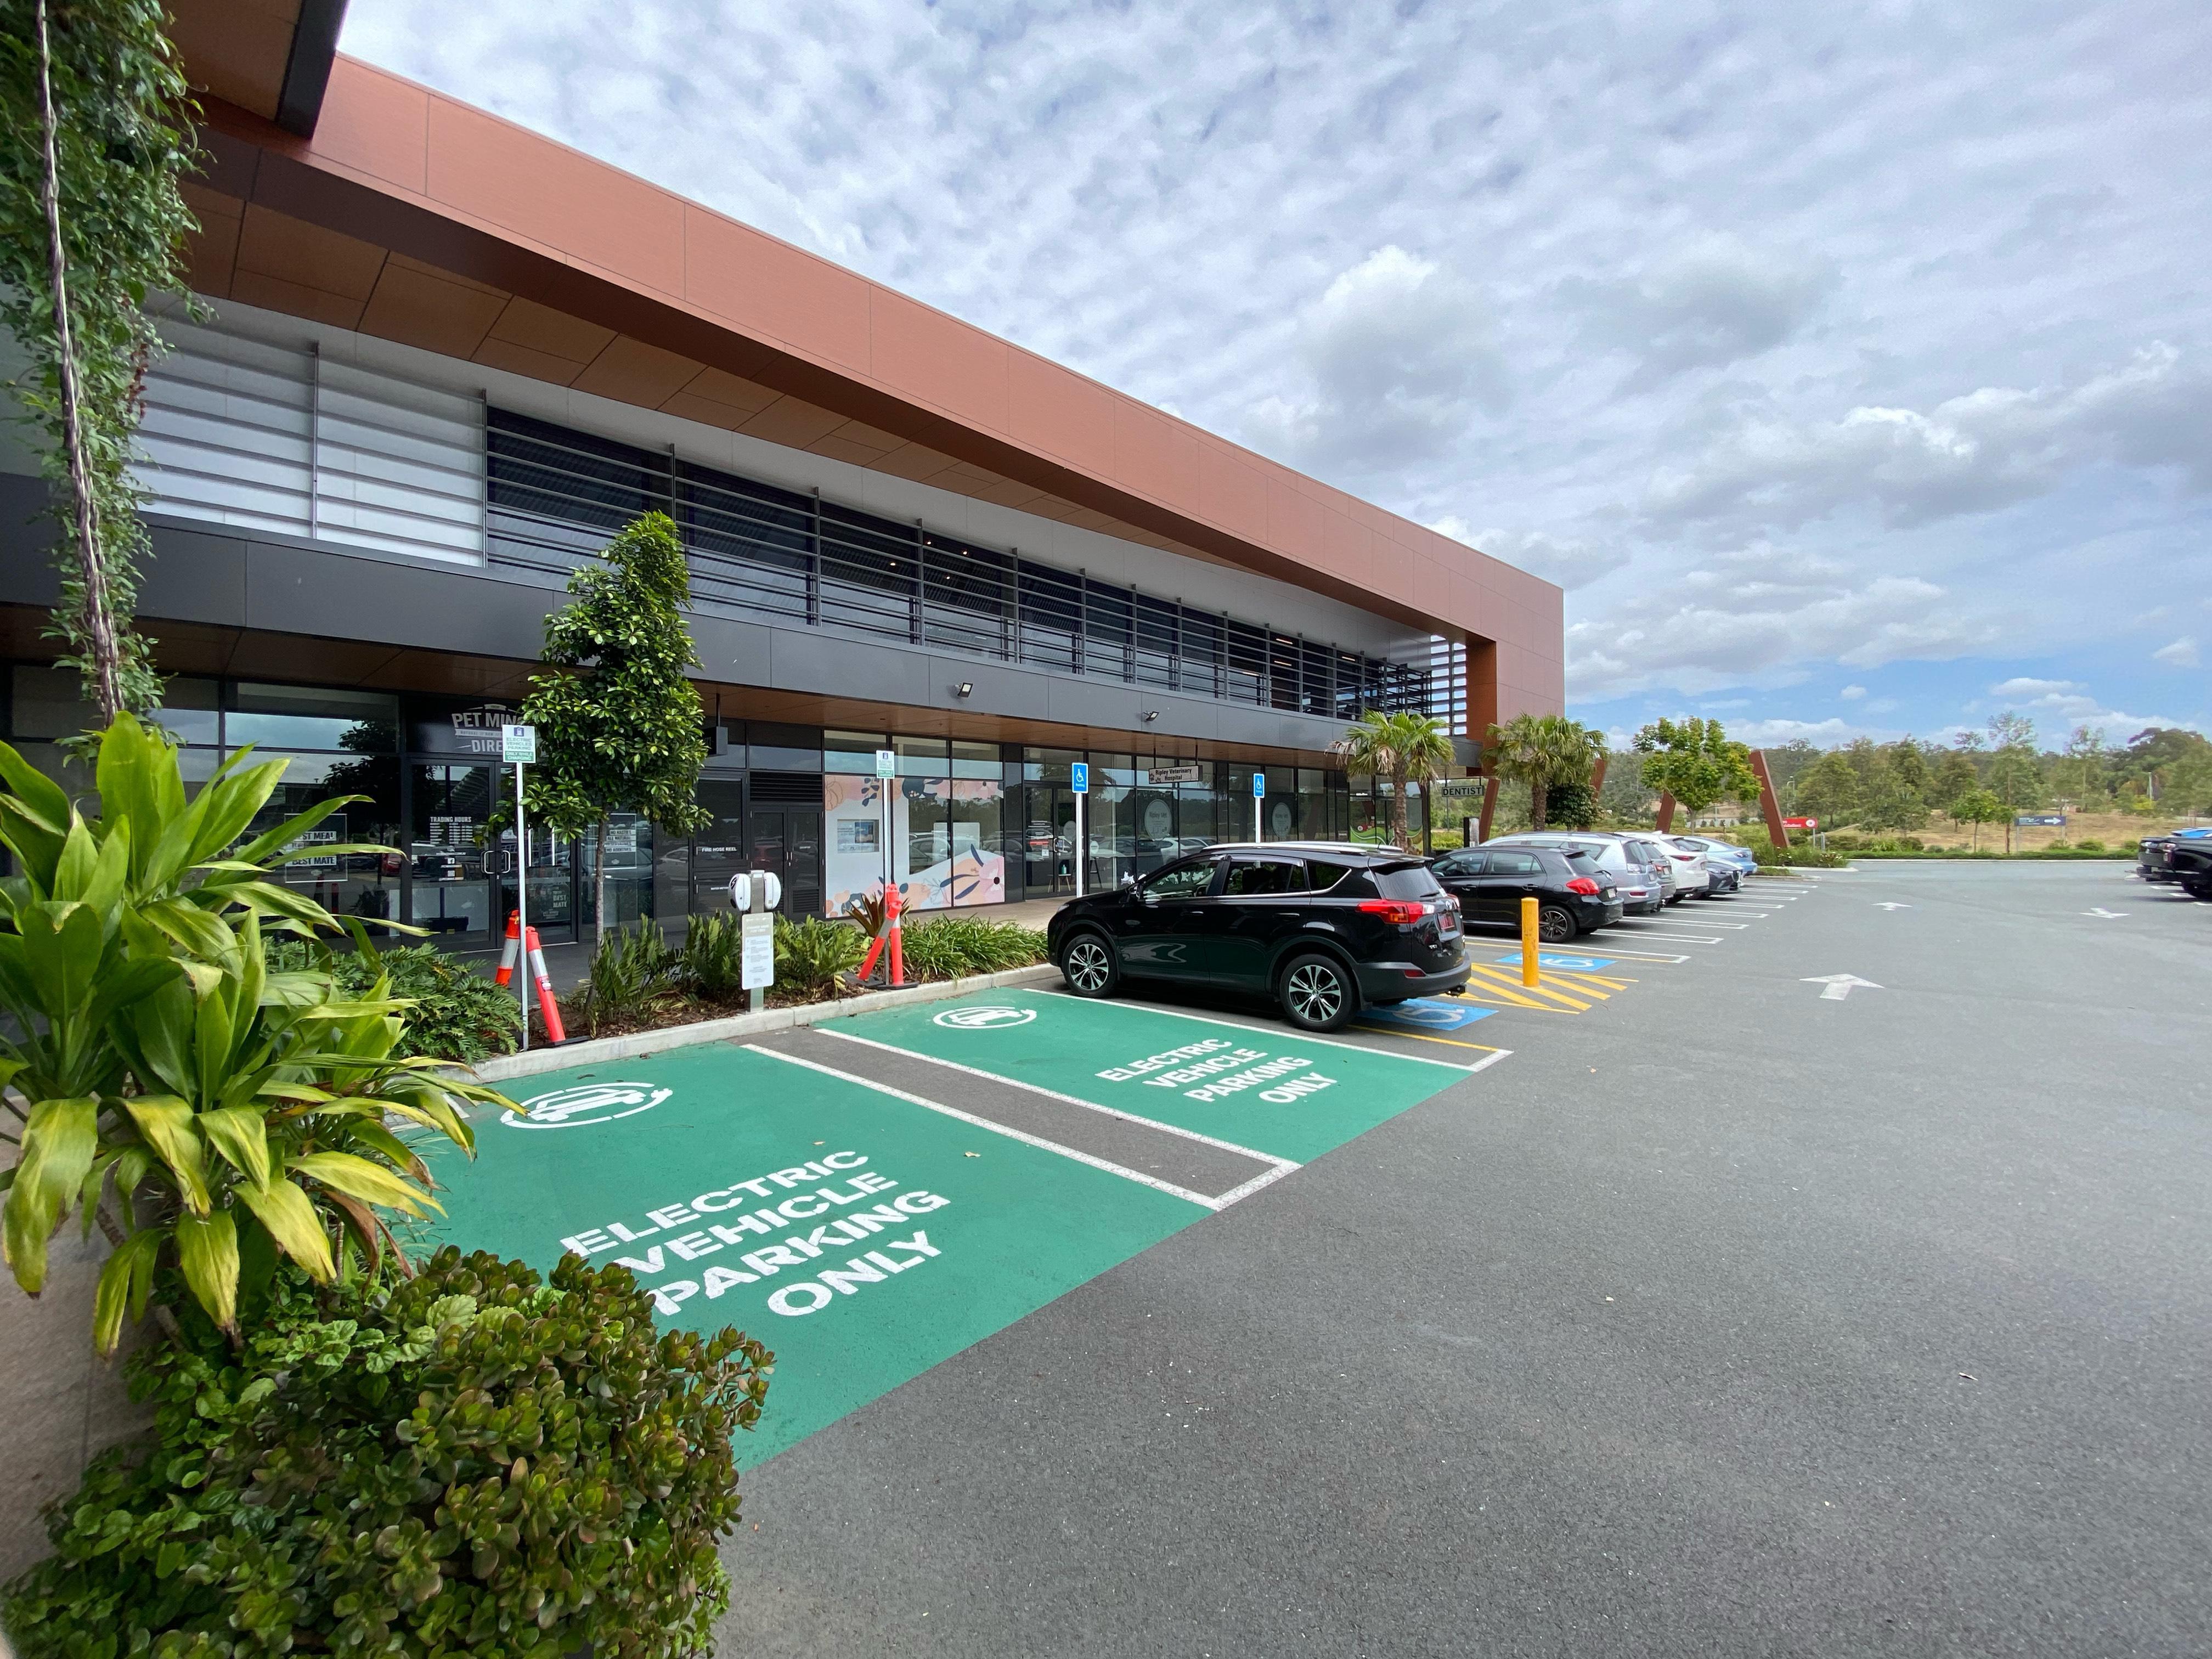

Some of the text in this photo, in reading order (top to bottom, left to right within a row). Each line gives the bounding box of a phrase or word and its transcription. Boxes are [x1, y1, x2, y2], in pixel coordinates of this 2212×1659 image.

[452, 713, 482, 728] PET
[471, 740, 503, 752] DIRE
[1443, 787, 1481, 795] DENTIST
[314, 856, 334, 865] MATE
[1094, 1039, 1233, 1082] ELECTRIC
[1142, 1048, 1268, 1088] VEHICLE
[1183, 1057, 1314, 1102] PARKING
[1259, 1071, 1338, 1103] ONLY
[560, 1151, 869, 1257] ELECTRIC
[613, 1171, 899, 1274] VEHICLE
[646, 1190, 951, 1316] PARKING
[767, 1230, 943, 1317] ONLY
